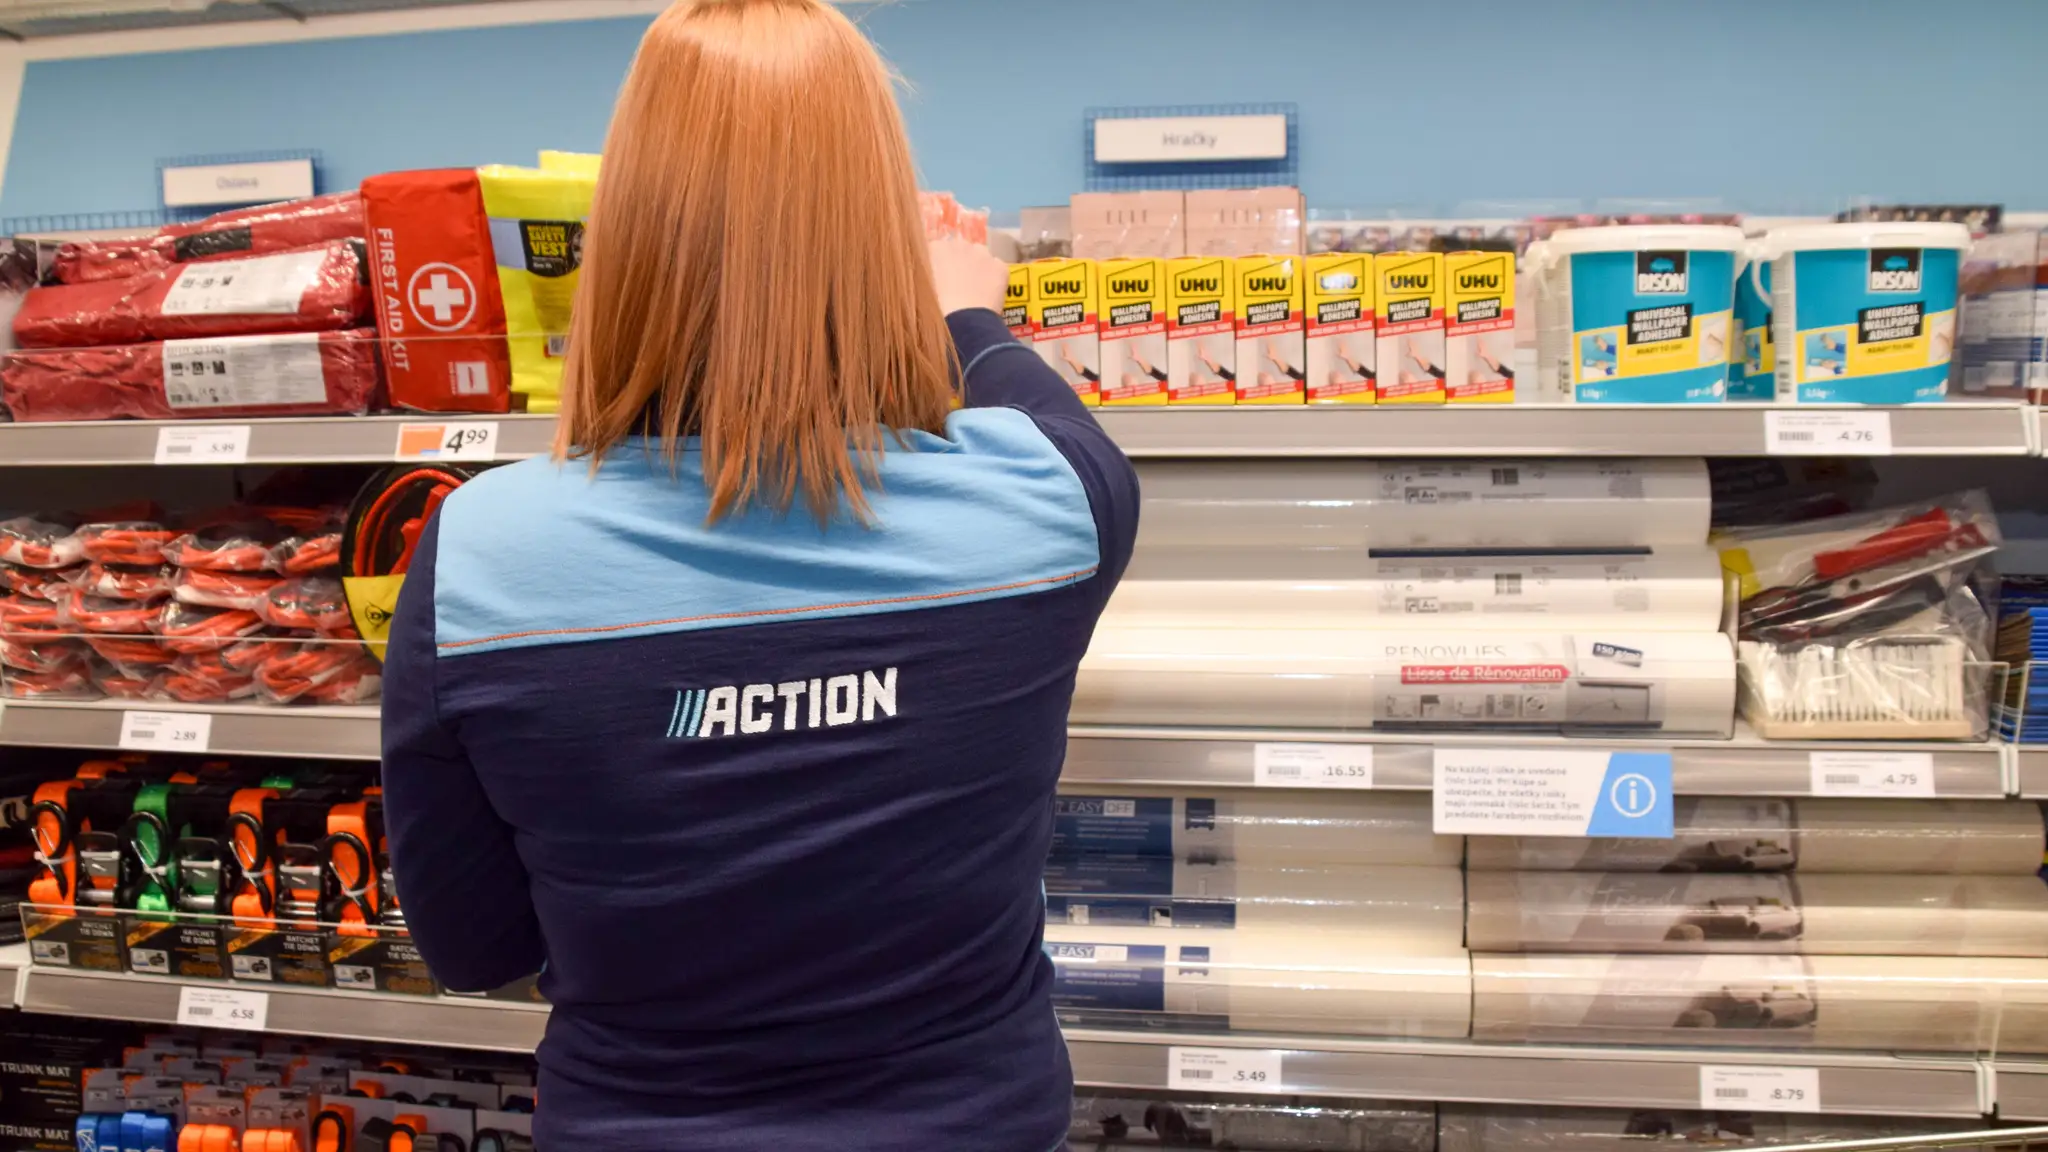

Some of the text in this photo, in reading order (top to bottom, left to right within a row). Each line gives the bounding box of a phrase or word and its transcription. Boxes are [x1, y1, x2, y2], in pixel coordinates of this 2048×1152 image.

[530, 241, 568, 257] VEST
[1044, 280, 1080, 294] UHU
[1112, 279, 1149, 294] UHU
[1180, 278, 1218, 292] UHU
[1249, 277, 1286, 291] UHU
[1390, 275, 1428, 289] UHU
[1460, 275, 1498, 289] UHU
[1638, 273, 1686, 291] BISON
[1871, 271, 1919, 290] BISON
[377, 228, 410, 372] FIRST AID KIT
[1389, 299, 1430, 313] WALLPAPER
[1459, 299, 1500, 313] WALLPAPER
[1043, 303, 1082, 317] WALLPAPER
[1111, 302, 1151, 317] WALLPAPER
[1179, 302, 1220, 316] WALLPAPER
[1248, 301, 1288, 315] WALLPAPER
[1319, 300, 1360, 315] WALLPAPER
[1392, 308, 1426, 321] ADHESIVE
[1462, 308, 1496, 321] ADHESIVE
[1634, 305, 1687, 321] UNIVERSAL
[1865, 304, 1919, 319] UNIVERSAL
[1047, 311, 1079, 326] ADHESIVE
[1115, 311, 1148, 325] ADHESIVE
[1183, 310, 1216, 324] ADHESIVE
[1251, 310, 1285, 323] ADHESIVE
[1323, 309, 1356, 323] ADHESIVE
[1862, 315, 1921, 331] WALLPAPER
[1632, 316, 1689, 332] WALLPAPER
[1636, 327, 1683, 342] ADHESIVE
[1867, 326, 1915, 341] ADHESIVE
[1407, 665, 1561, 681] Lisse de Rénovation
[698, 667, 897, 737] ACTION
[1327, 765, 1366, 777] 16.55
[1886, 773, 1918, 785] 4.79
[1070, 801, 1134, 814] EASY OFF
[80, 928, 114, 938] TIE DOWN
[82, 921, 112, 931] RATCHET
[182, 928, 215, 938] RATCHET
[179, 935, 216, 945] TIE DOWN
[286, 935, 319, 945] RATCHET
[283, 942, 320, 953] TIE DOWN
[1059, 946, 1094, 958] EASY
[387, 951, 400, 960] TIE
[0, 1061, 71, 1077] TRUNK MAT
[1238, 1070, 1266, 1082] 5.49
[1773, 1088, 1804, 1101] 8.79
[0, 1124, 69, 1140] TRUNK MAT
